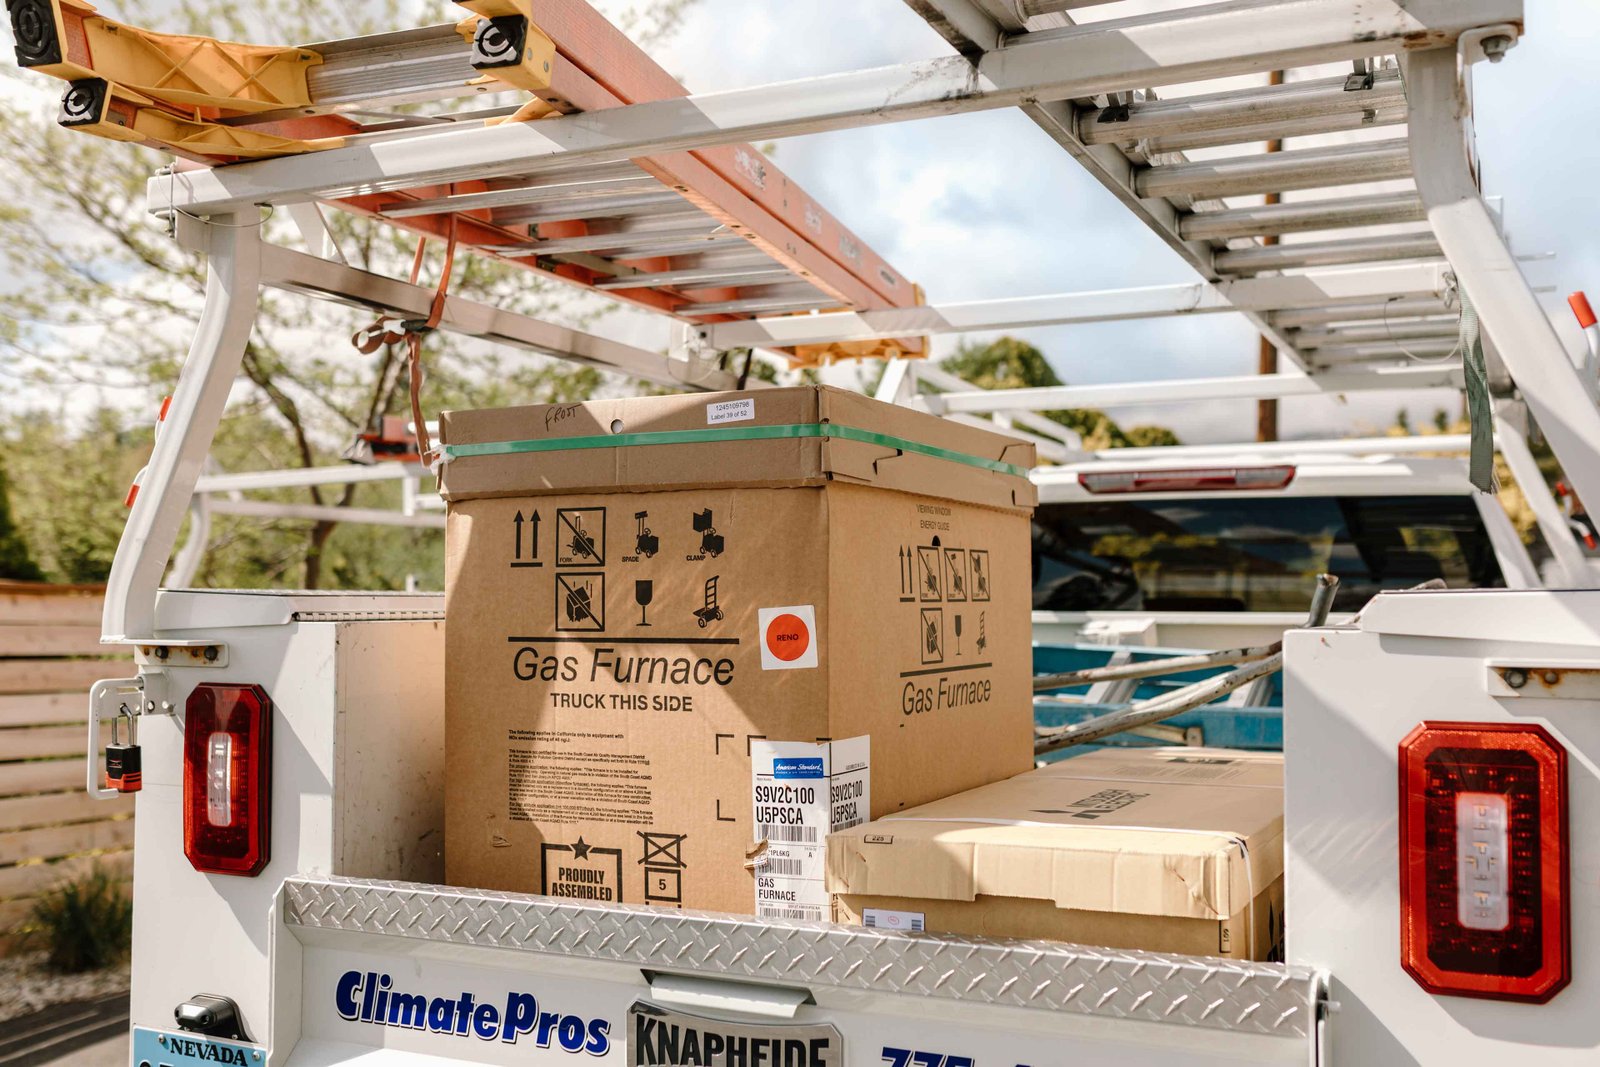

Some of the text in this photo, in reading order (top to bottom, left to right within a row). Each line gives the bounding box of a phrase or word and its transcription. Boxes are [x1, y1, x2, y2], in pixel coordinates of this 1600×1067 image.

[920, 520, 950, 531] ENERGY GUIDE
[776, 634, 799, 642] RENO
[512, 647, 735, 686] Gas Furnace
[550, 692, 693, 712] TRUCK THIS SIDE
[902, 677, 992, 716] Gas Furnace
[756, 786, 815, 804] S9V2C100
[756, 806, 804, 825] U5PSCA
[558, 866, 605, 884] PROUDLY
[658, 878, 667, 890] 5
[758, 878, 775, 888] GAS
[552, 882, 612, 902] ASSEMBLED
[758, 889, 796, 902] FURNACE
[335, 970, 611, 1056] ClimatePros
[170, 1038, 248, 1066] NEVADA
